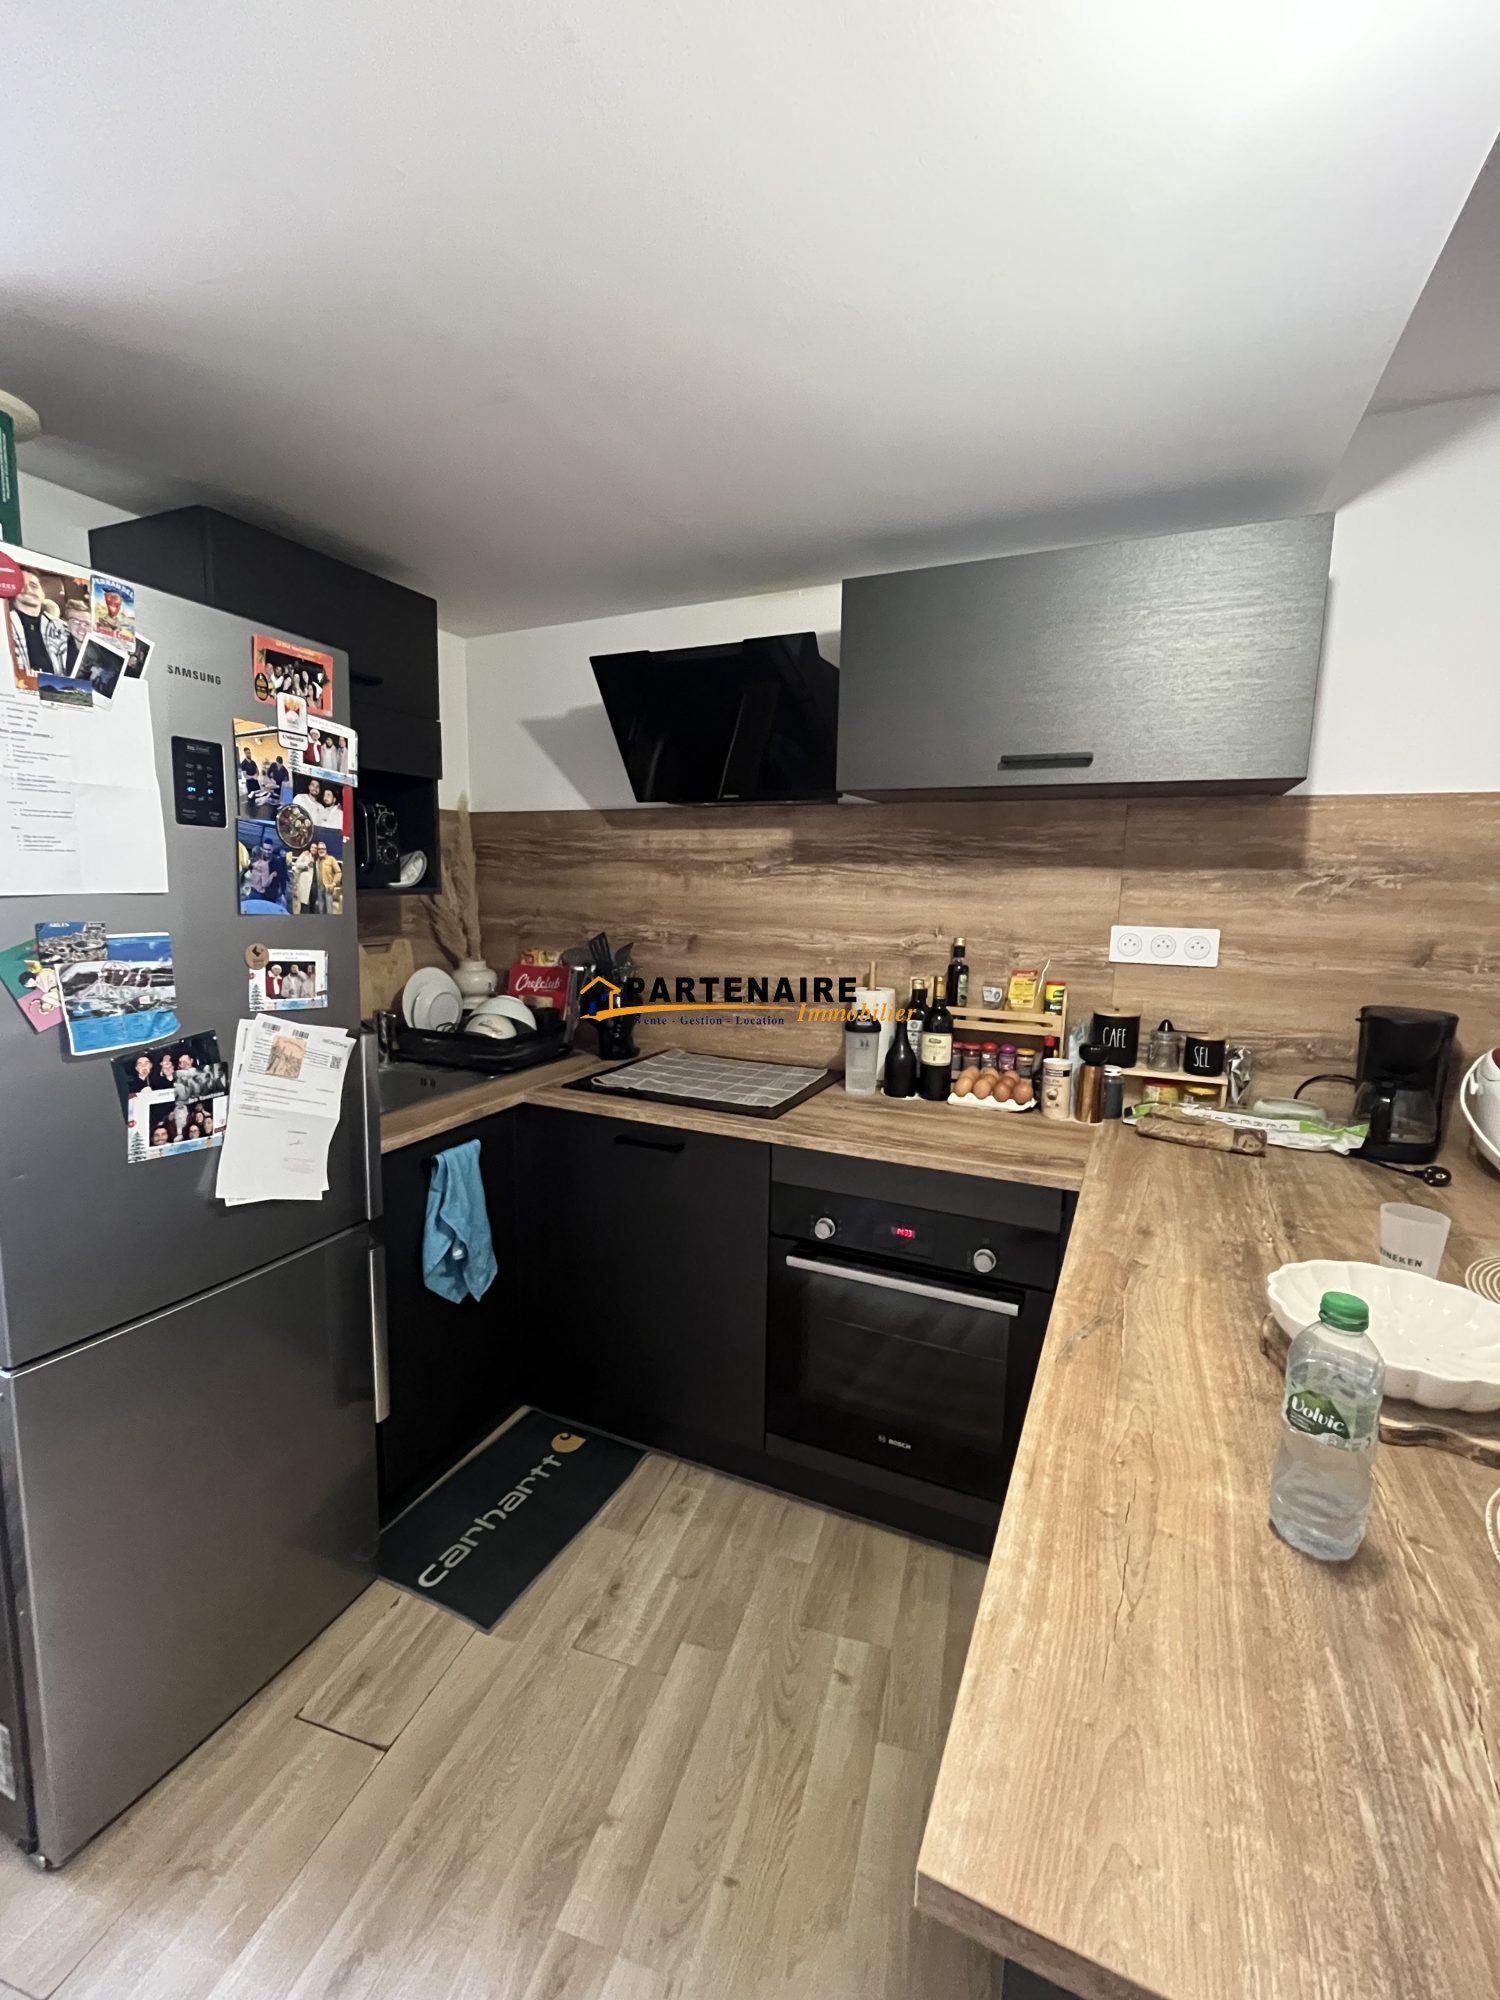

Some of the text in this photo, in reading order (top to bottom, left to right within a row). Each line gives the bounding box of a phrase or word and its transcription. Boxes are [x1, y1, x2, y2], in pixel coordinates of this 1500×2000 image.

[167, 664, 222, 685] SAMSUNG
[515, 973, 561, 993] Chefclub
[1102, 1026, 1128, 1049] CAFE
[1193, 1045, 1211, 1068] SEL
[1291, 1395, 1346, 1433] Volvic
[417, 1454, 562, 1588] carhartt
